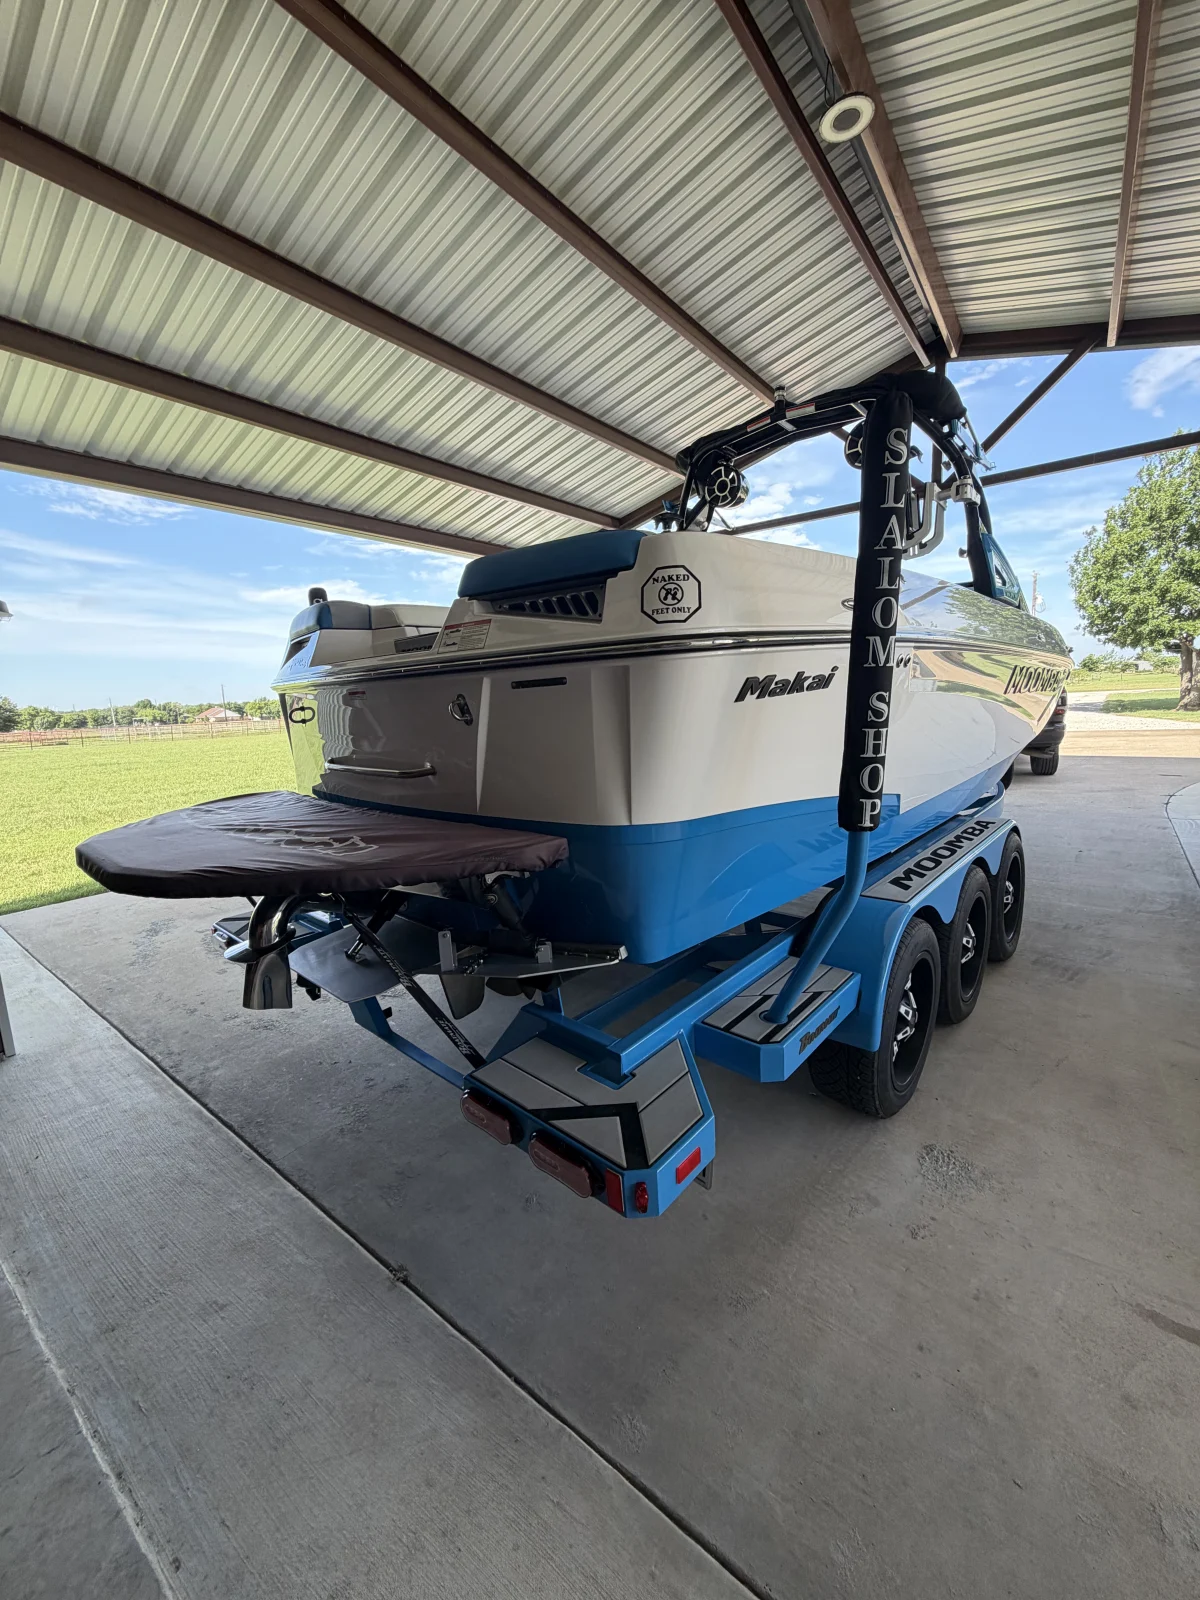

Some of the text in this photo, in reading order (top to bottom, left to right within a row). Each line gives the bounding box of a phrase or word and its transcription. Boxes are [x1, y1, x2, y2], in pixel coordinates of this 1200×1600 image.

[652, 574, 690, 585] NAKED
[651, 606, 692, 616] FEET ONLY
[857, 427, 908, 828] SLALOM SHOP
[733, 665, 839, 703] Makai
[887, 820, 997, 891] MOOMBA
